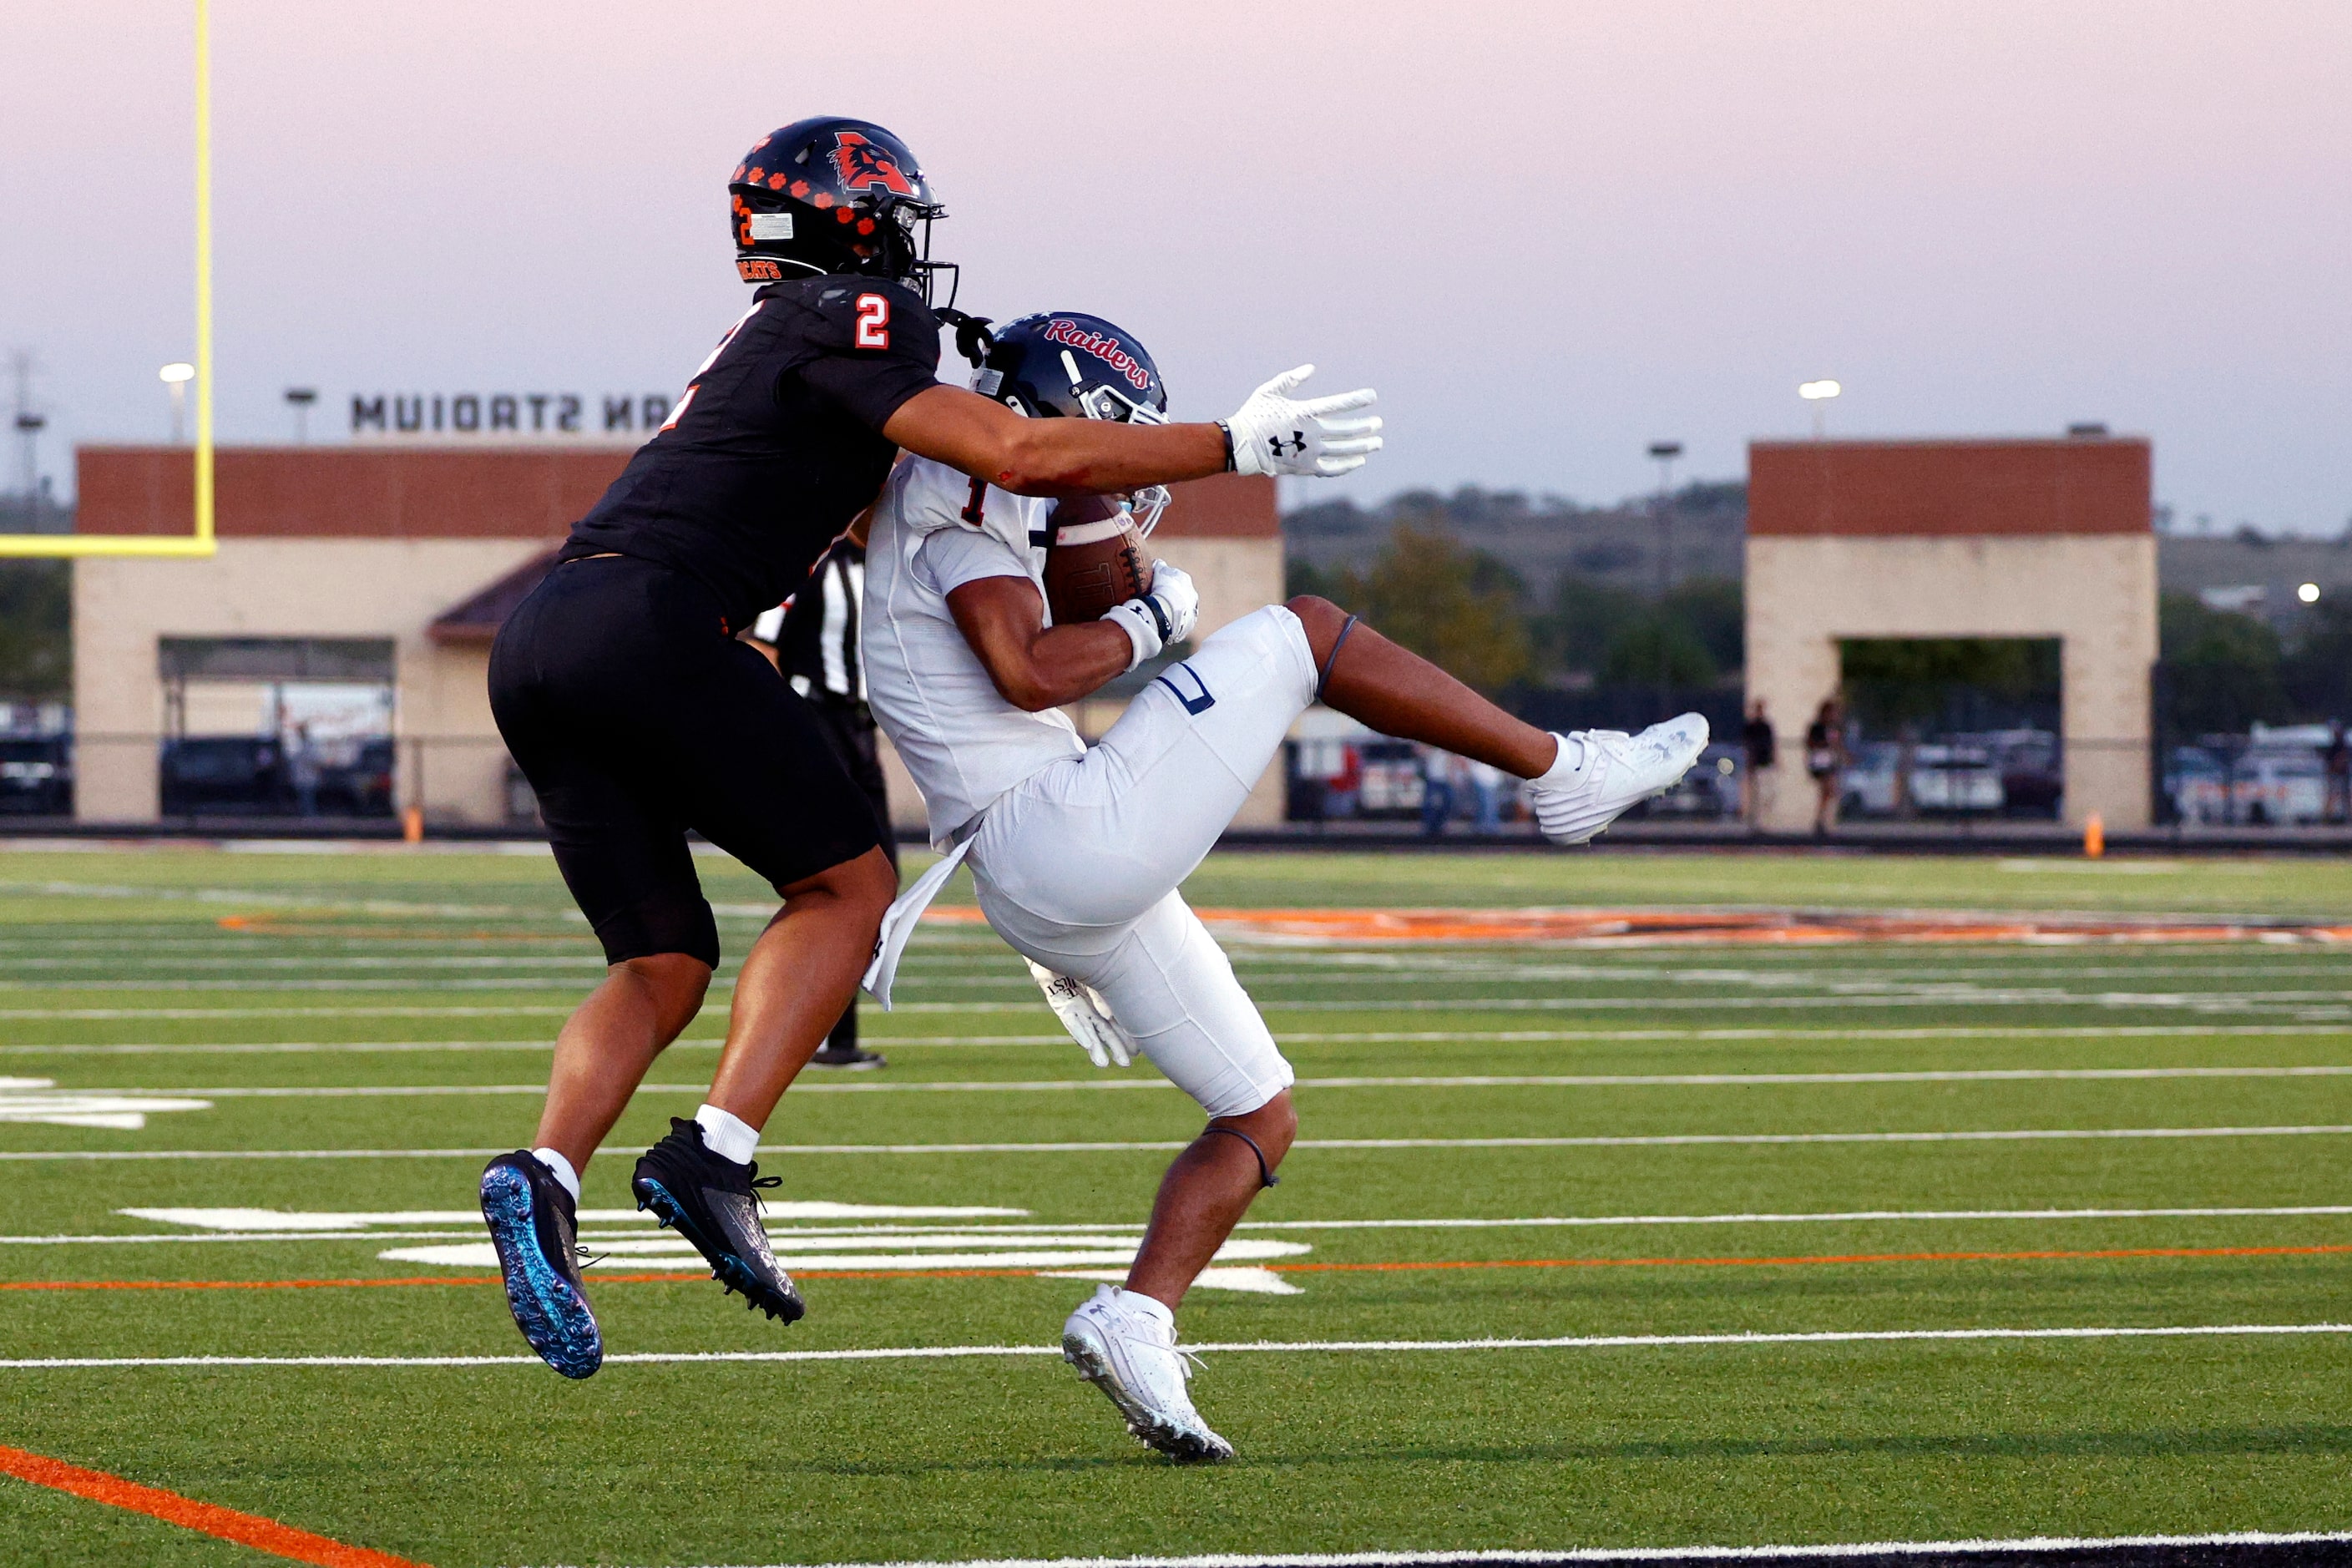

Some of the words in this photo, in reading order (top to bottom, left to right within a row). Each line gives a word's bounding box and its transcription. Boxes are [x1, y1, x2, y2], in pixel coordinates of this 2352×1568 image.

[855, 293, 889, 350] 2
[1044, 319, 1150, 389] Raiders
[961, 476, 989, 527] 1
